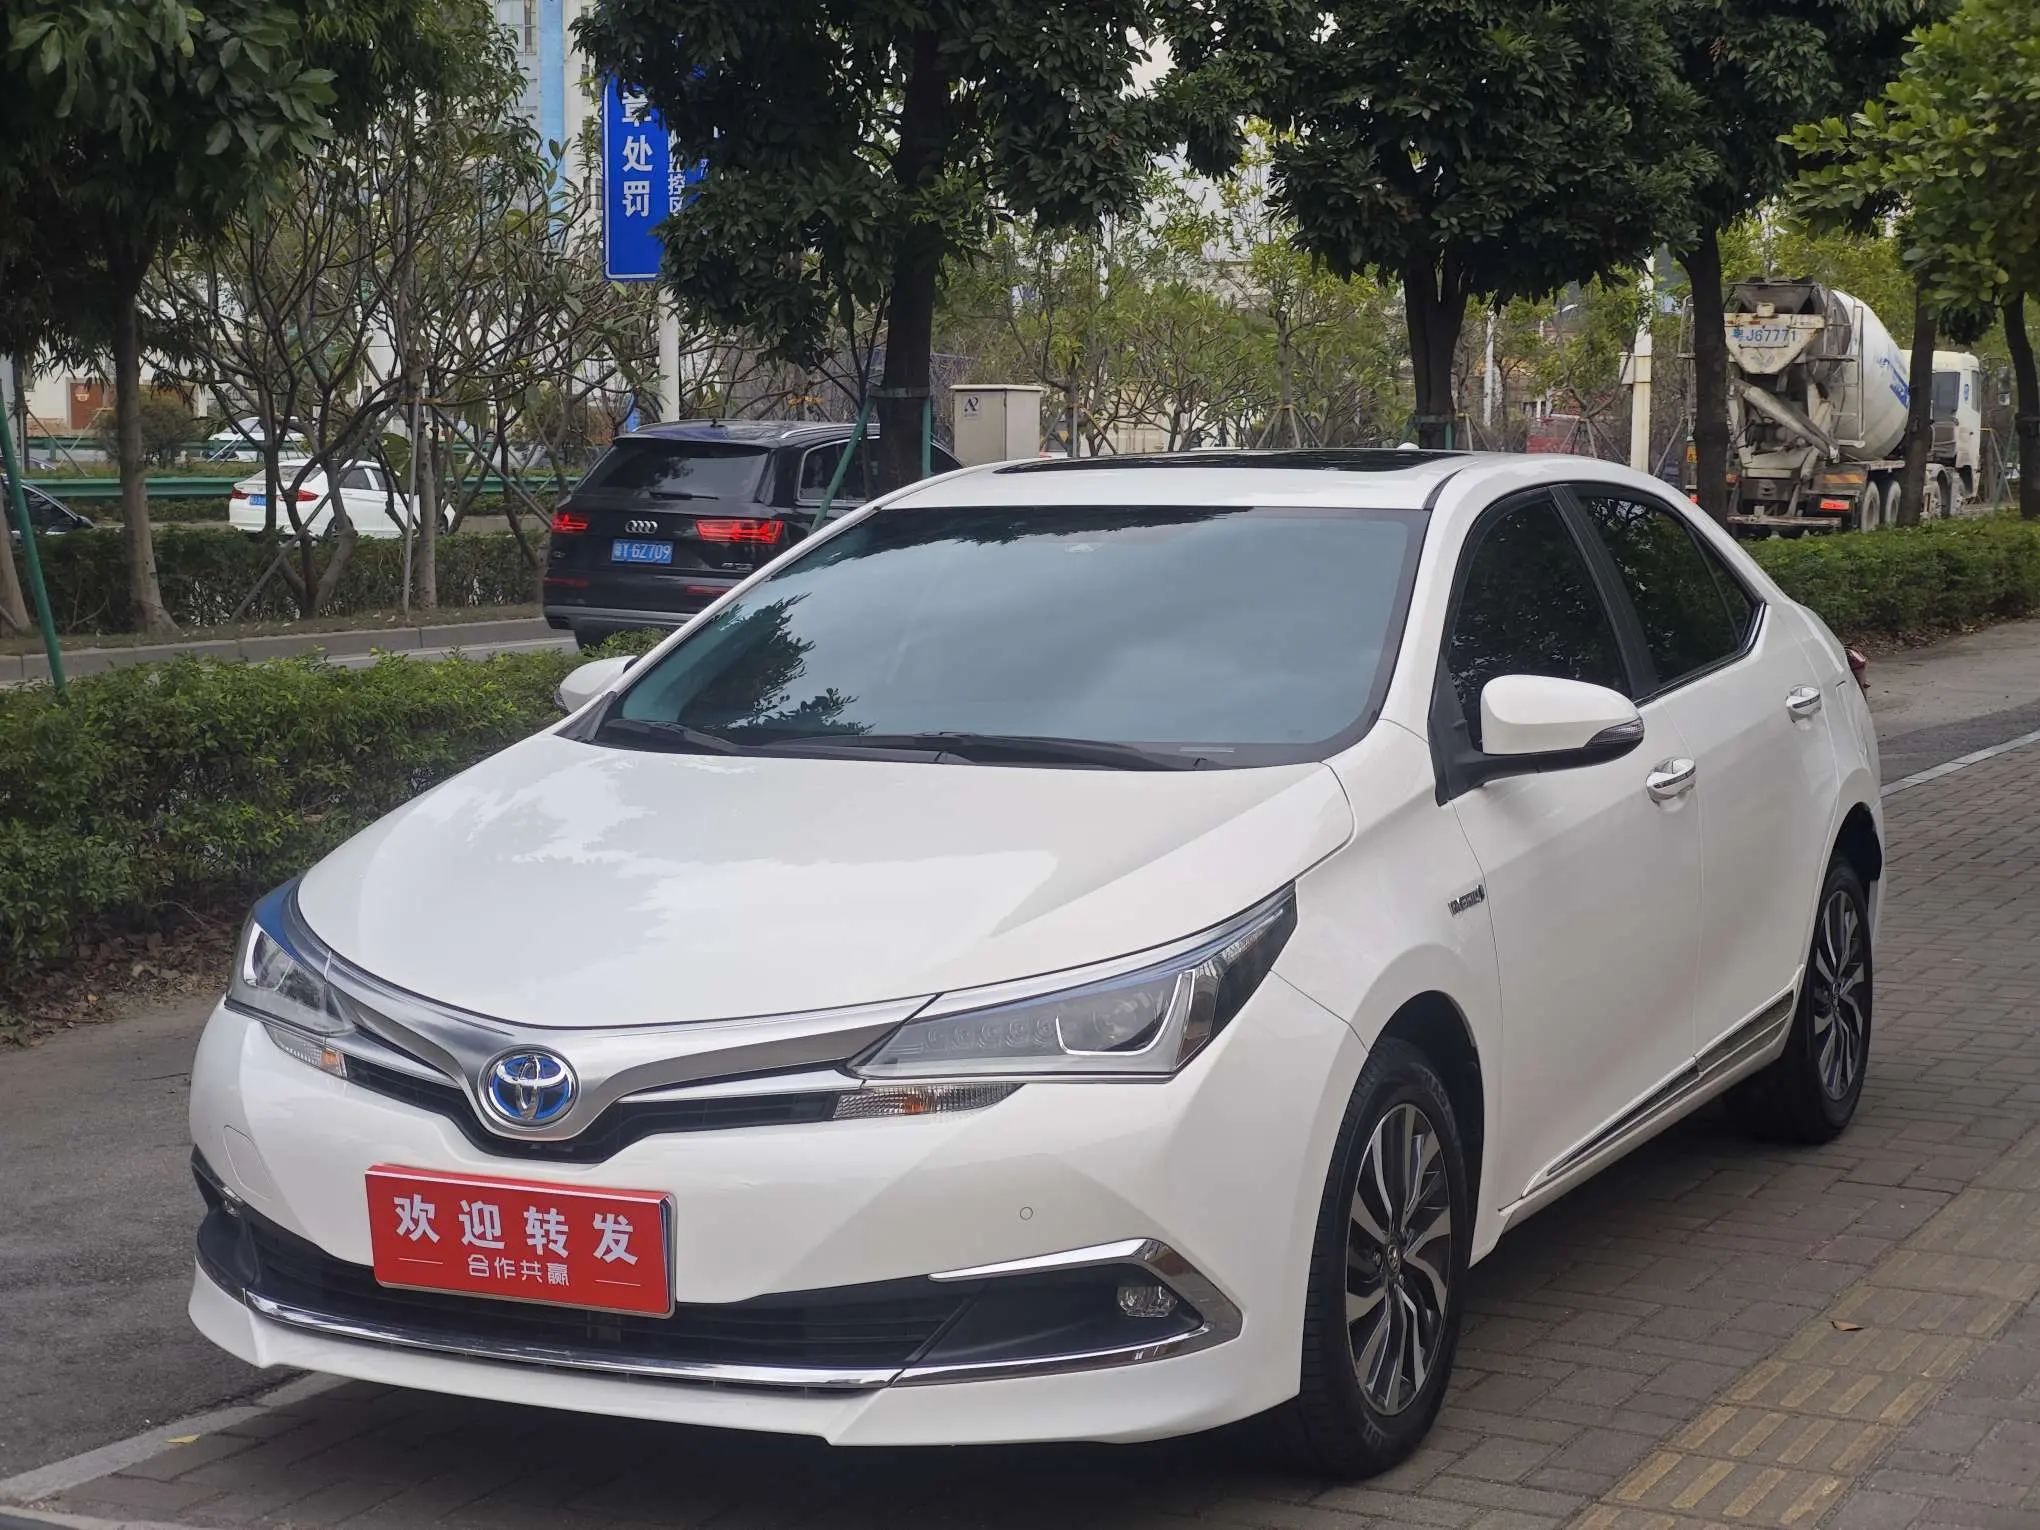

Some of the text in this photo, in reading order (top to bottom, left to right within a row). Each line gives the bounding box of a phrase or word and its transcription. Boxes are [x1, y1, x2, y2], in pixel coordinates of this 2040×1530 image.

[393, 1193, 639, 1265] 欢迎转发
[467, 1253, 570, 1286] 合作共赢
